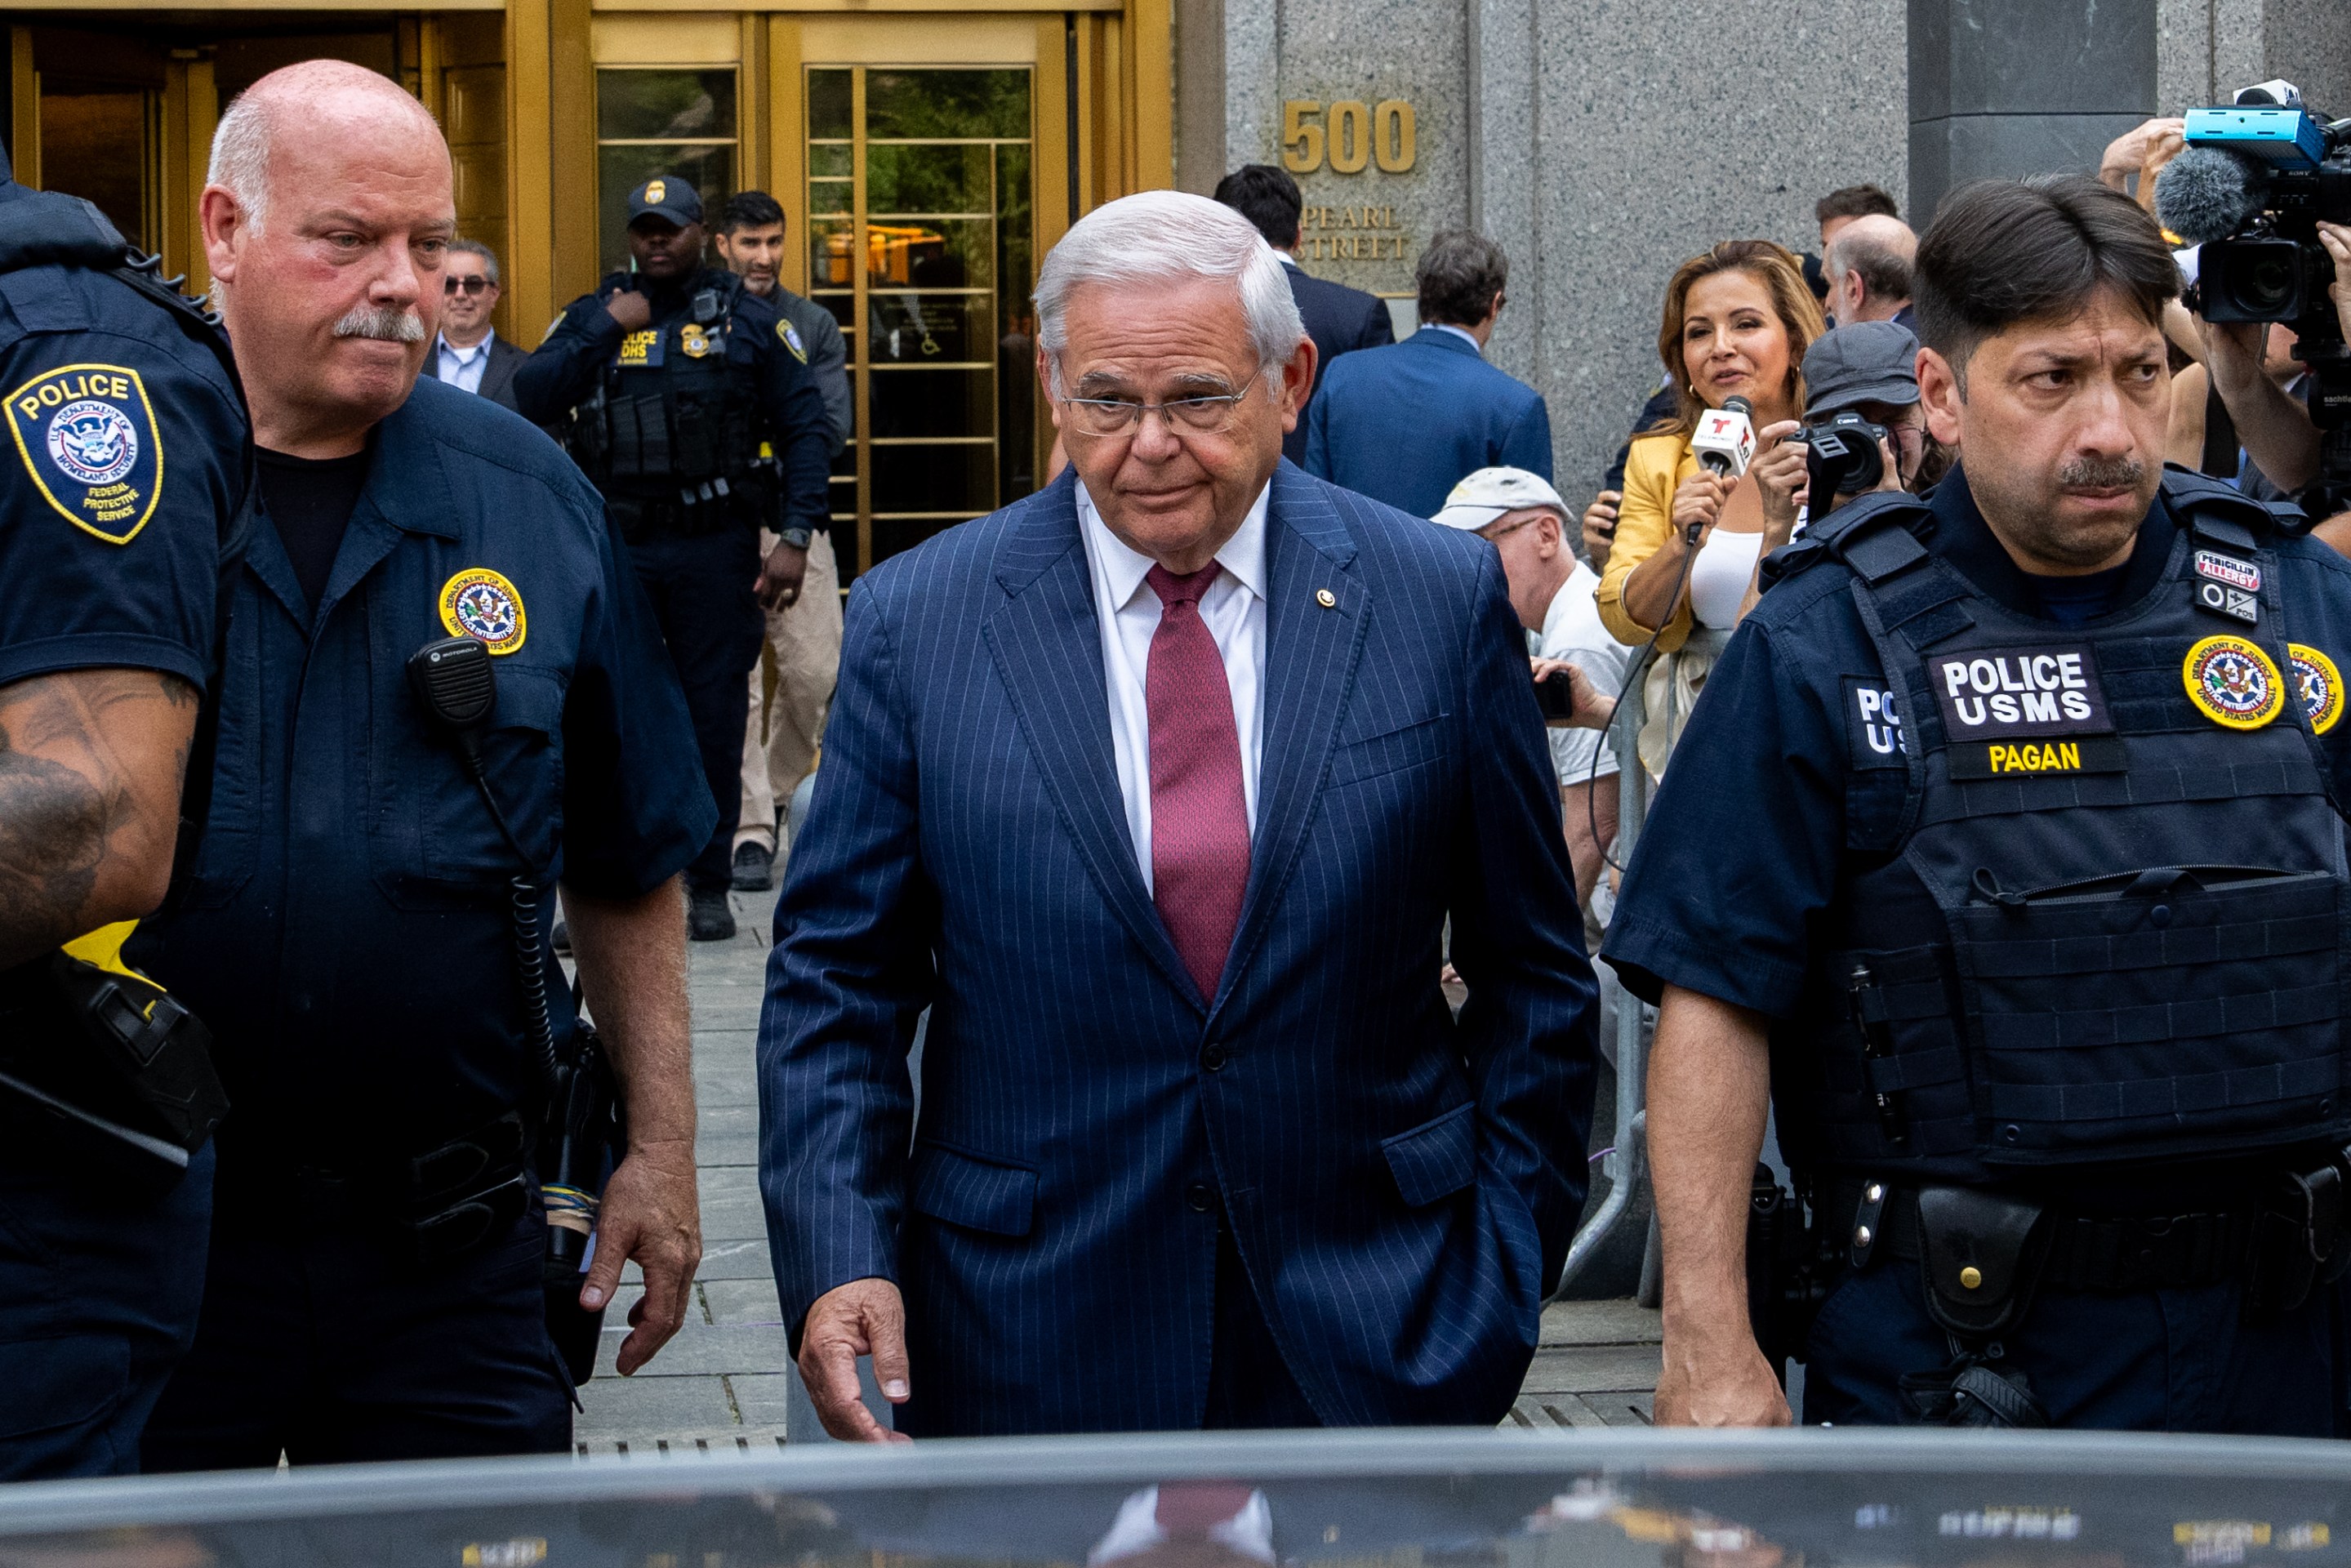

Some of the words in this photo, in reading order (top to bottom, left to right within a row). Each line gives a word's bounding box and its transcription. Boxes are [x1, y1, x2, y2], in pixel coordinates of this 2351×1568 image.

[1284, 99, 1416, 173] 500
[1302, 207, 1401, 230] PEARL
[623, 330, 657, 344] LICE
[621, 344, 646, 358] DHS
[19, 374, 129, 421] POLICE
[57, 454, 108, 481] HOMELAND
[110, 442, 135, 478] SECURITY
[83, 488, 140, 508] PROTECTIVE
[88, 482, 129, 497] FEDERAL
[96, 505, 136, 521] SERVICE
[2202, 554, 2254, 577] PENICILLIN
[2202, 562, 2255, 589] ALLERGY
[447, 575, 485, 608] DEPARTMENT
[489, 577, 499, 585] OF
[2202, 583, 2224, 607] O
[2236, 608, 2254, 618] POS
[449, 617, 470, 637] UNITE
[443, 647, 478, 657] MOTOROLA
[2193, 642, 2229, 679] DEPARTMENT
[2233, 644, 2245, 652] OF
[2246, 651, 2273, 679] JUSTICE
[1942, 653, 2087, 697] POLICE
[2307, 656, 2334, 684] JUSTICE
[1955, 691, 2091, 725] USMS
[2197, 688, 2223, 714] UNITED
[2224, 711, 2255, 721] STATES
[2255, 687, 2276, 718] MARSHAL
[2313, 692, 2336, 726] MARSHAL
[1988, 742, 2082, 773] PAGAN
